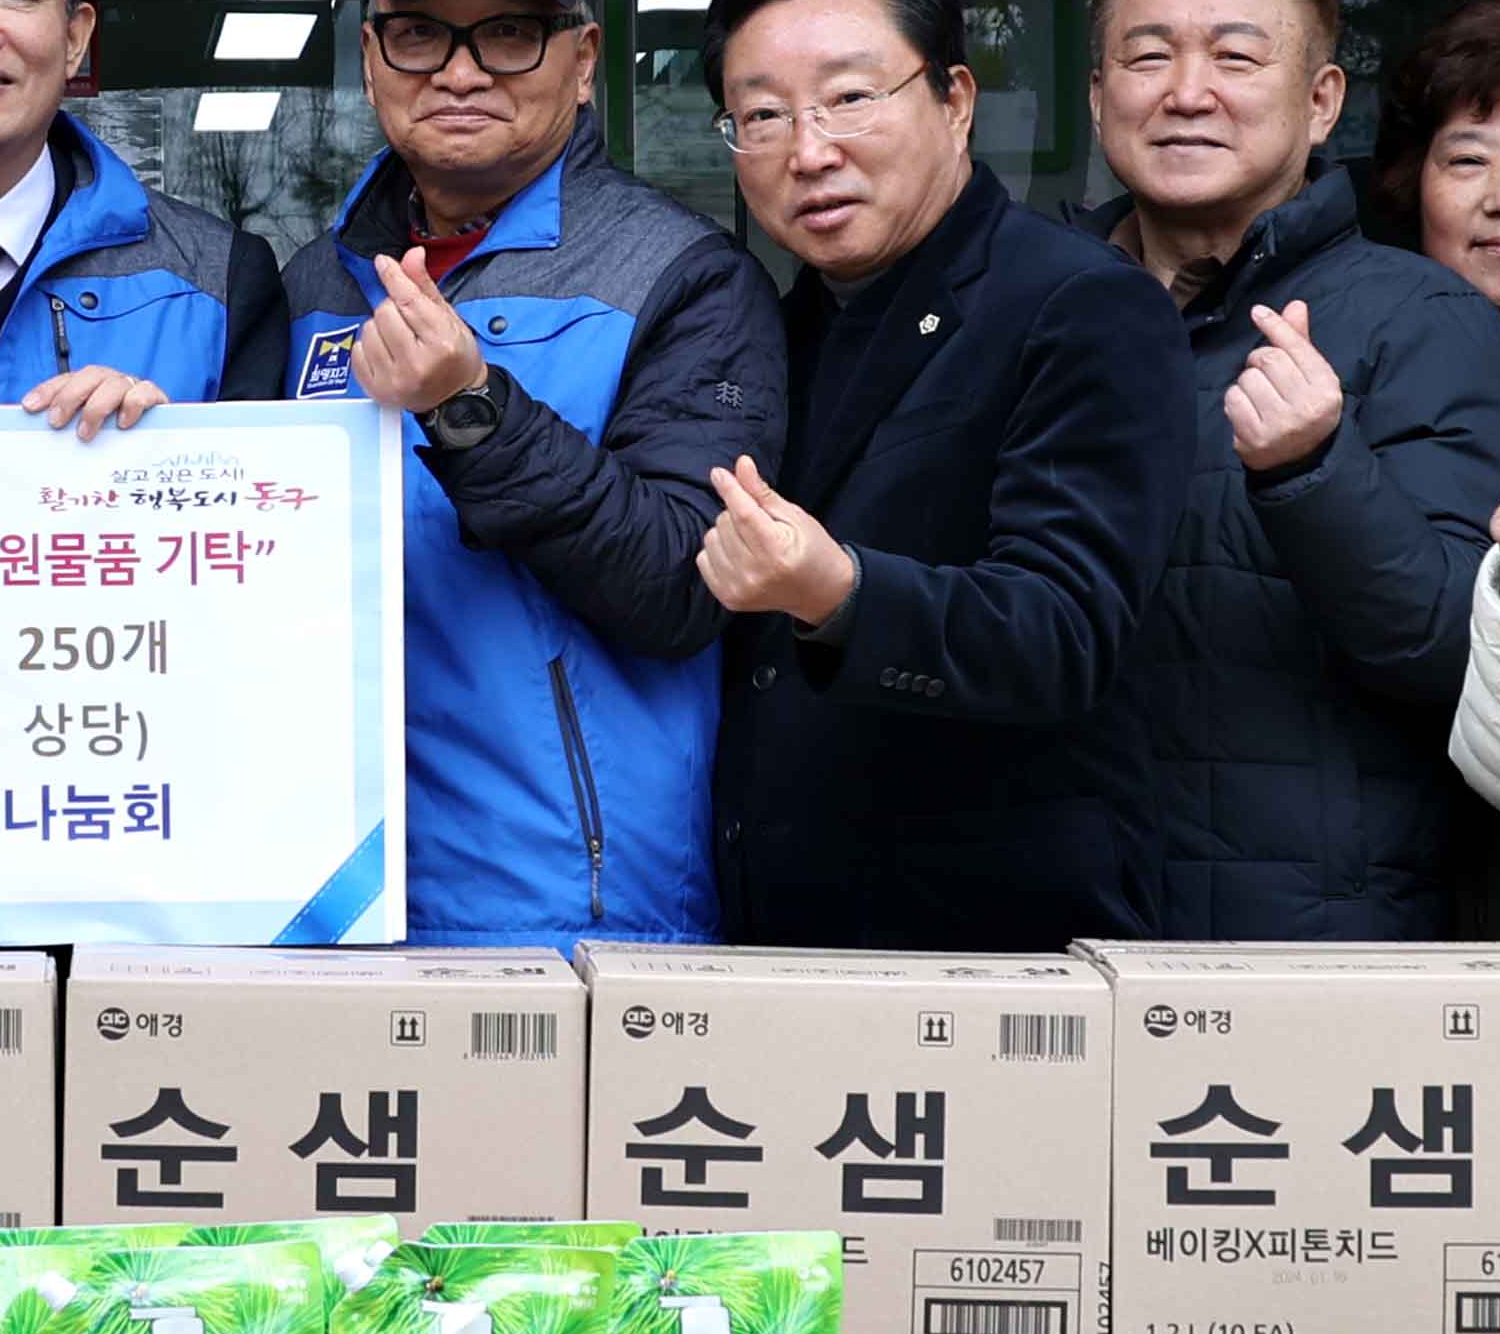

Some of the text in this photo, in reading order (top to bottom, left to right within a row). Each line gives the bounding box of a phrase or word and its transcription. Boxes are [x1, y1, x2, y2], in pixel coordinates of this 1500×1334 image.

[38, 482, 318, 512] 활기찬 행복도시 동구
[111, 468, 244, 483] 살고 싶은 도시!
[19, 620, 167, 674] 250개
[24, 702, 147, 761] 상당)
[5, 783, 170, 841] 나눔회
[1183, 1010, 1231, 1034] 애경
[100, 1087, 418, 1213] 순 샘
[625, 1086, 945, 1215] 순 샘
[1149, 1084, 1473, 1209] 순 샘
[1146, 1227, 1398, 1264] 베이킹X피톤치드
